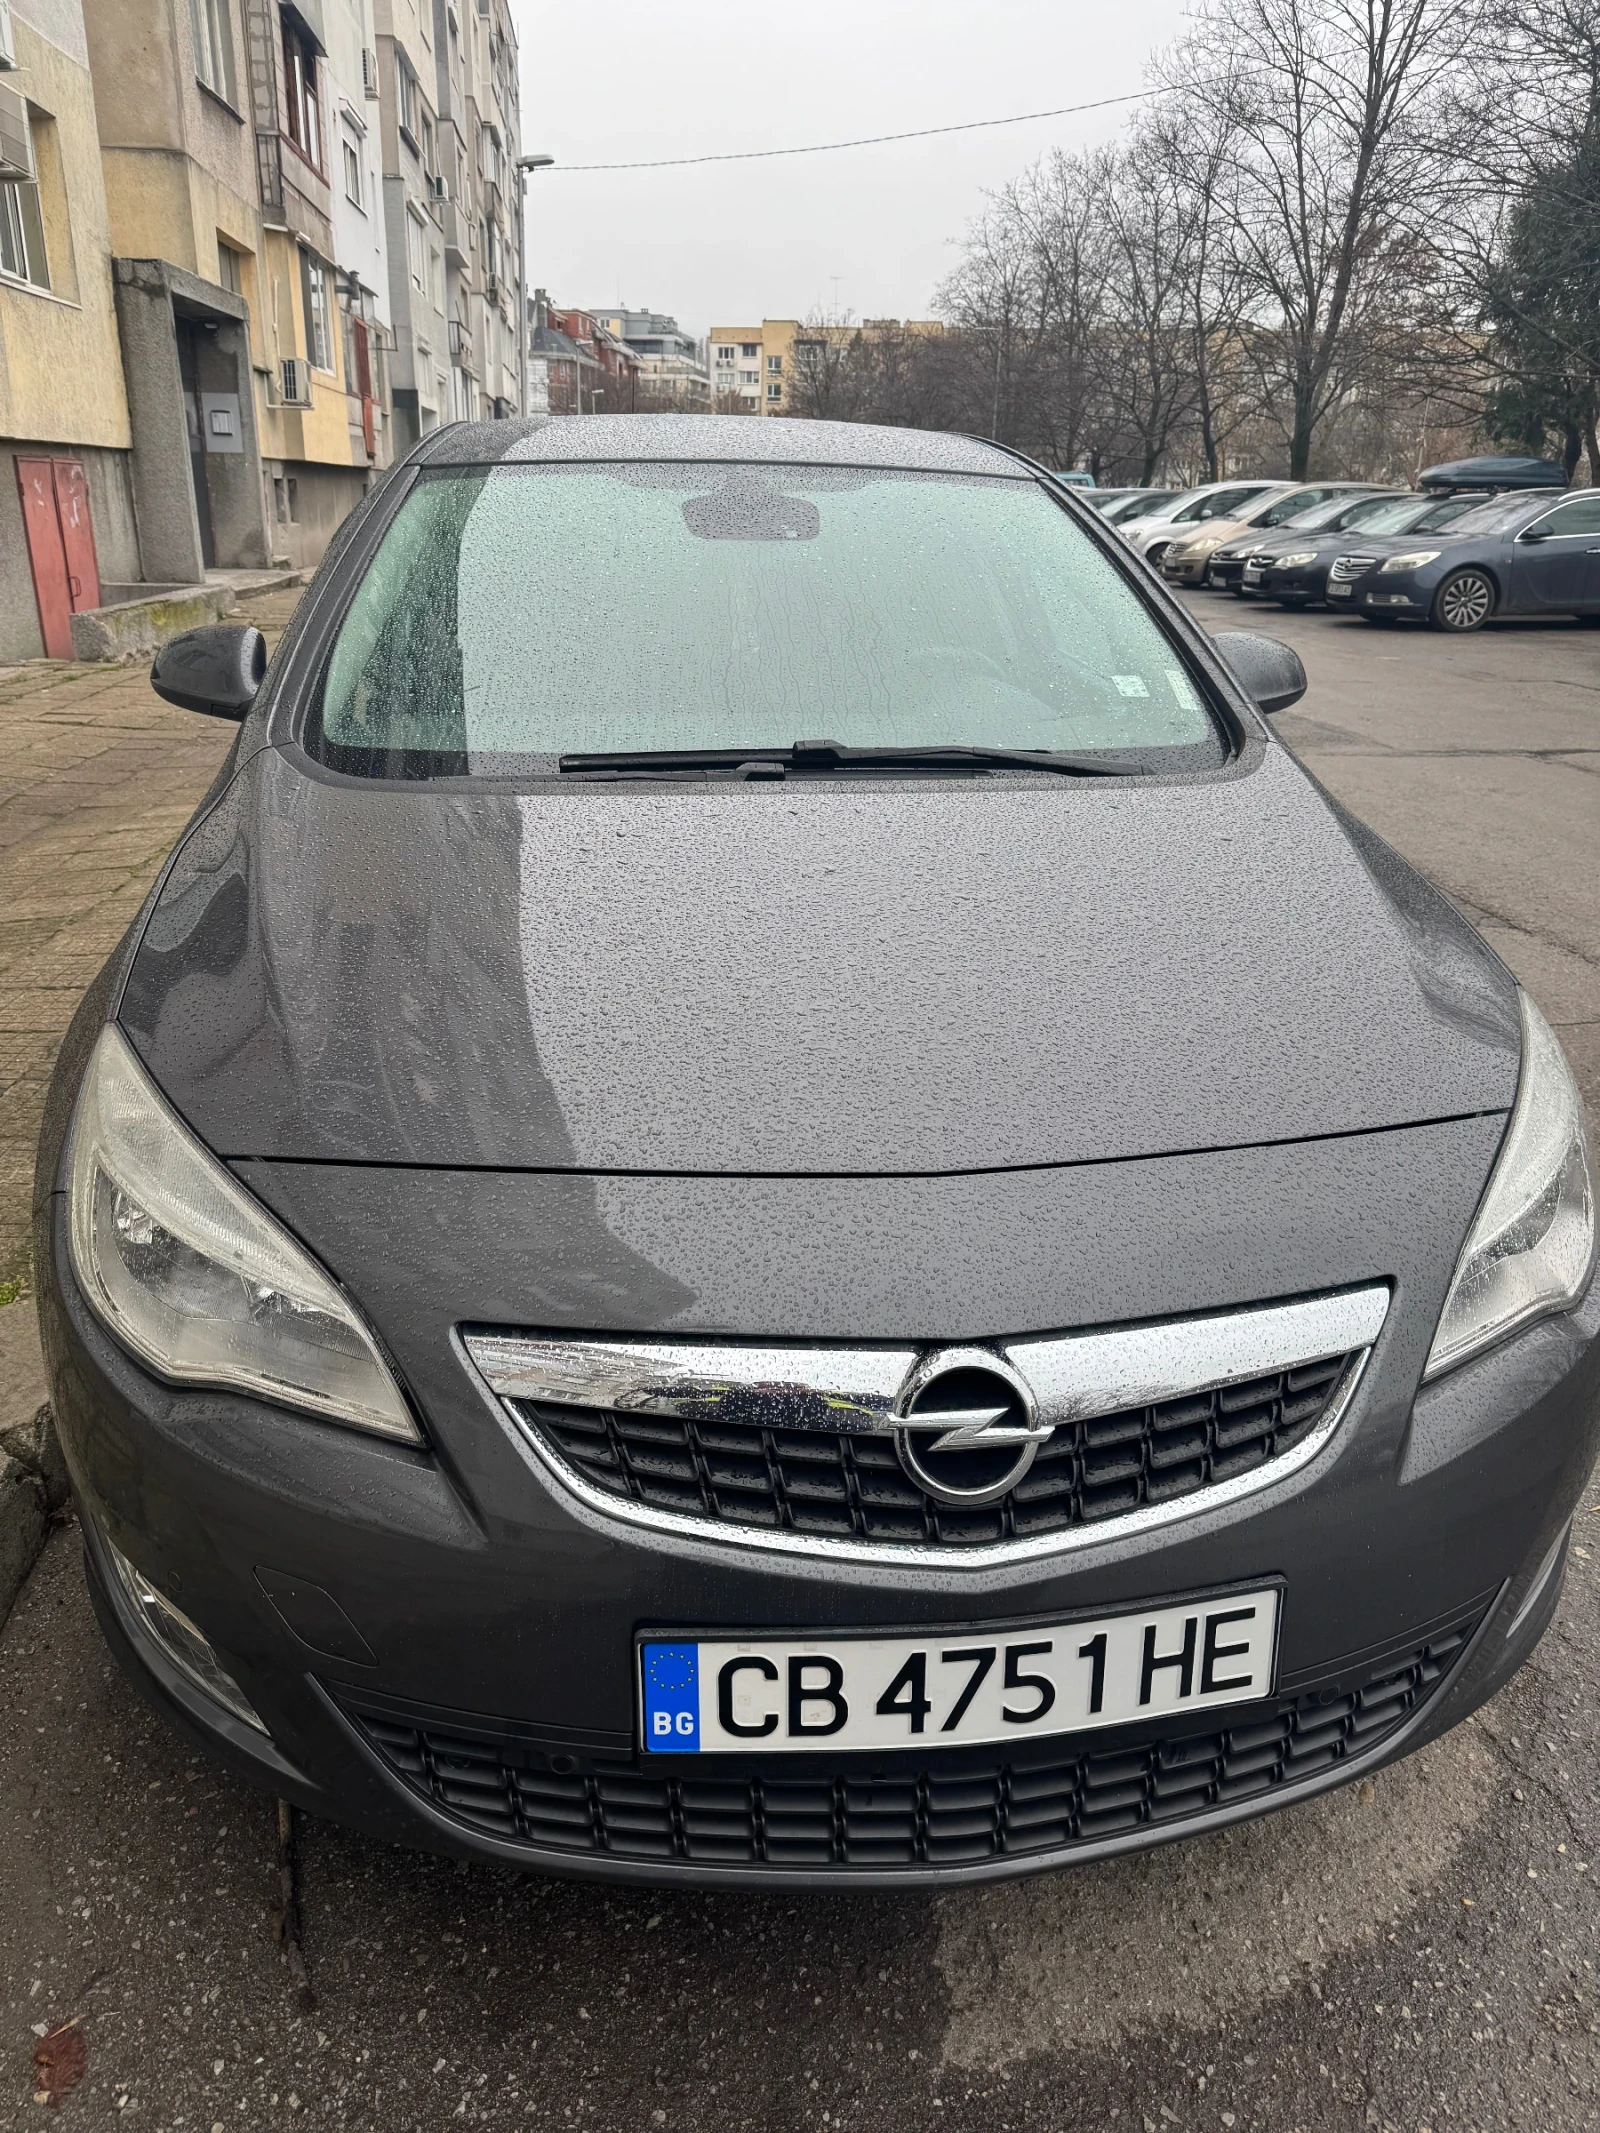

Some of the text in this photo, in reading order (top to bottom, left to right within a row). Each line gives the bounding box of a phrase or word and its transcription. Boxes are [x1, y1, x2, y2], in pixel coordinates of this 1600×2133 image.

[717, 1606, 1257, 1738] CB 4751 HE
[653, 1711, 694, 1735] BG
